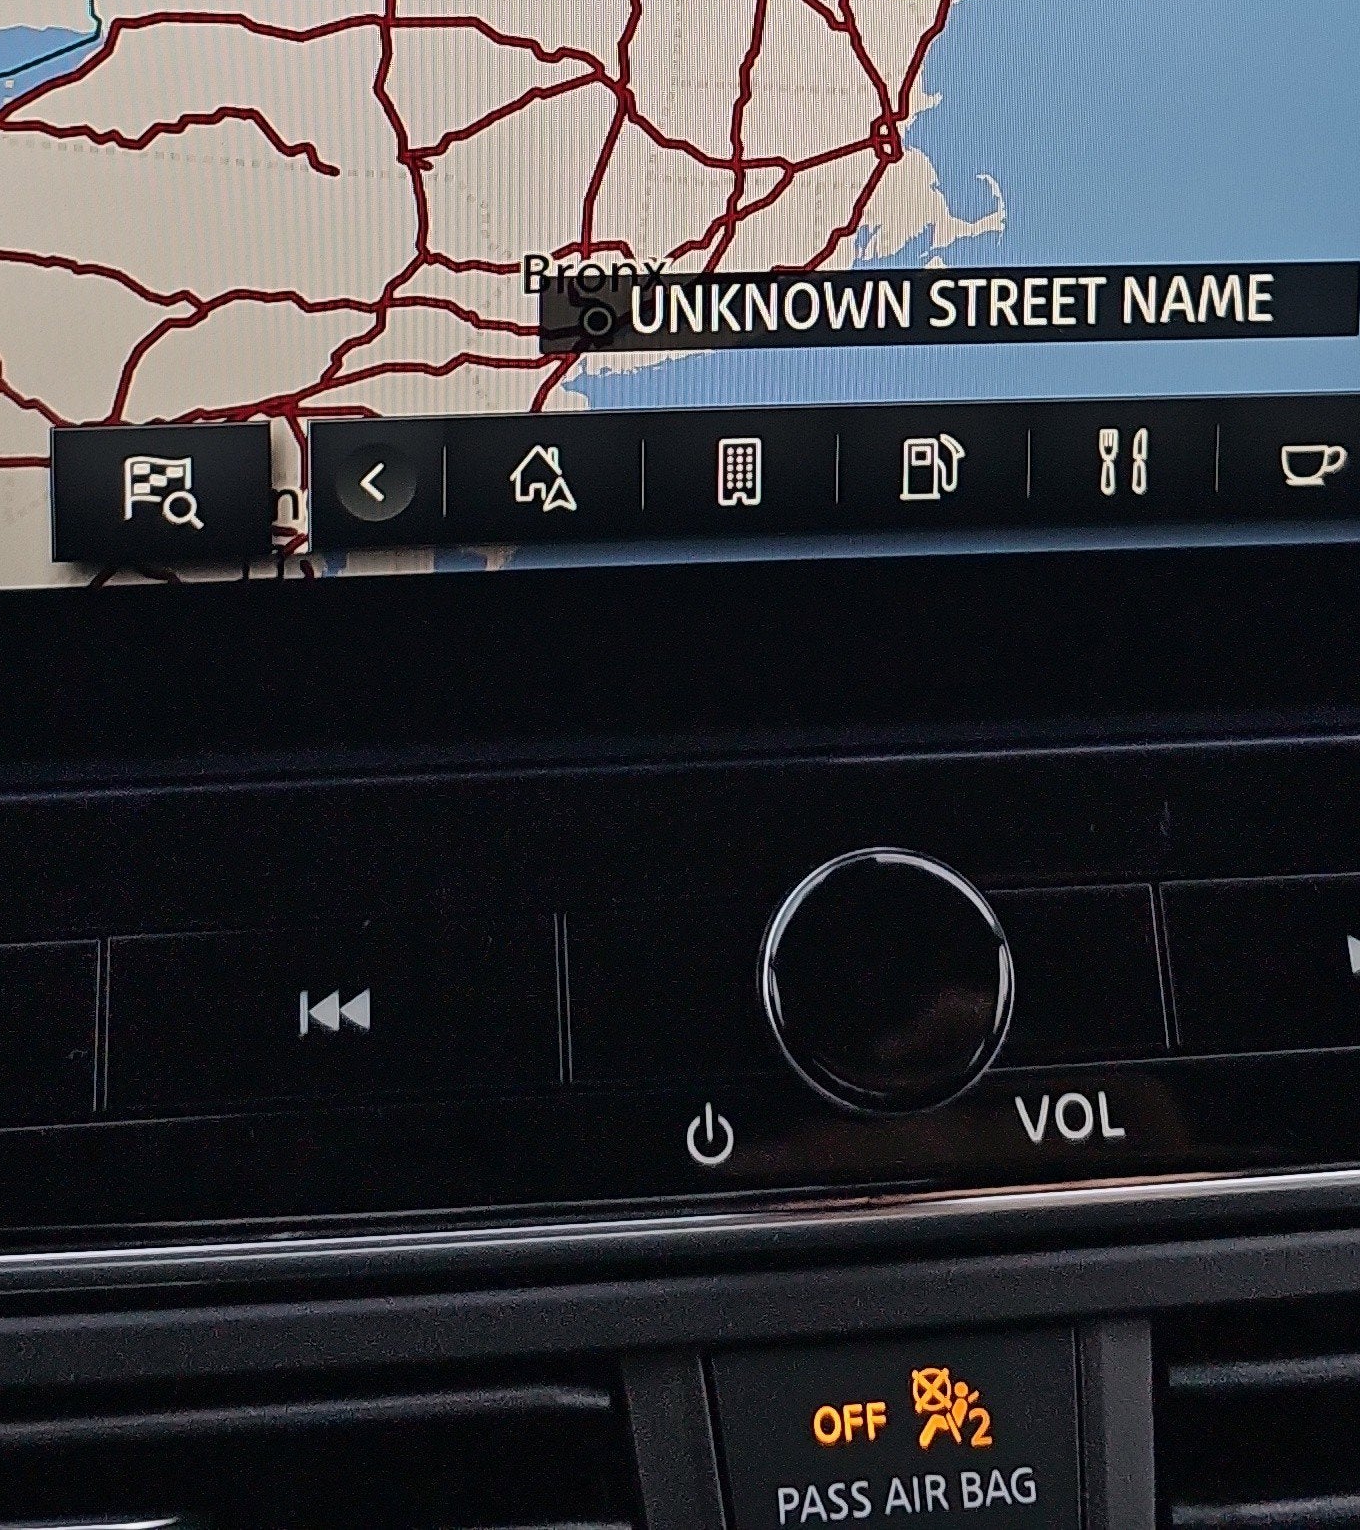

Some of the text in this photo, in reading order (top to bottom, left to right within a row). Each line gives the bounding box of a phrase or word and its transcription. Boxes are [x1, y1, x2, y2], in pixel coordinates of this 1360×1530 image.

[523, 253, 669, 295] Bronx
[631, 273, 1276, 334] UNKNOWN STREET NAME
[1014, 1090, 1128, 1144] VOL
[813, 1400, 888, 1445] OFF
[777, 1466, 1038, 1526] PASS AIR BAG
